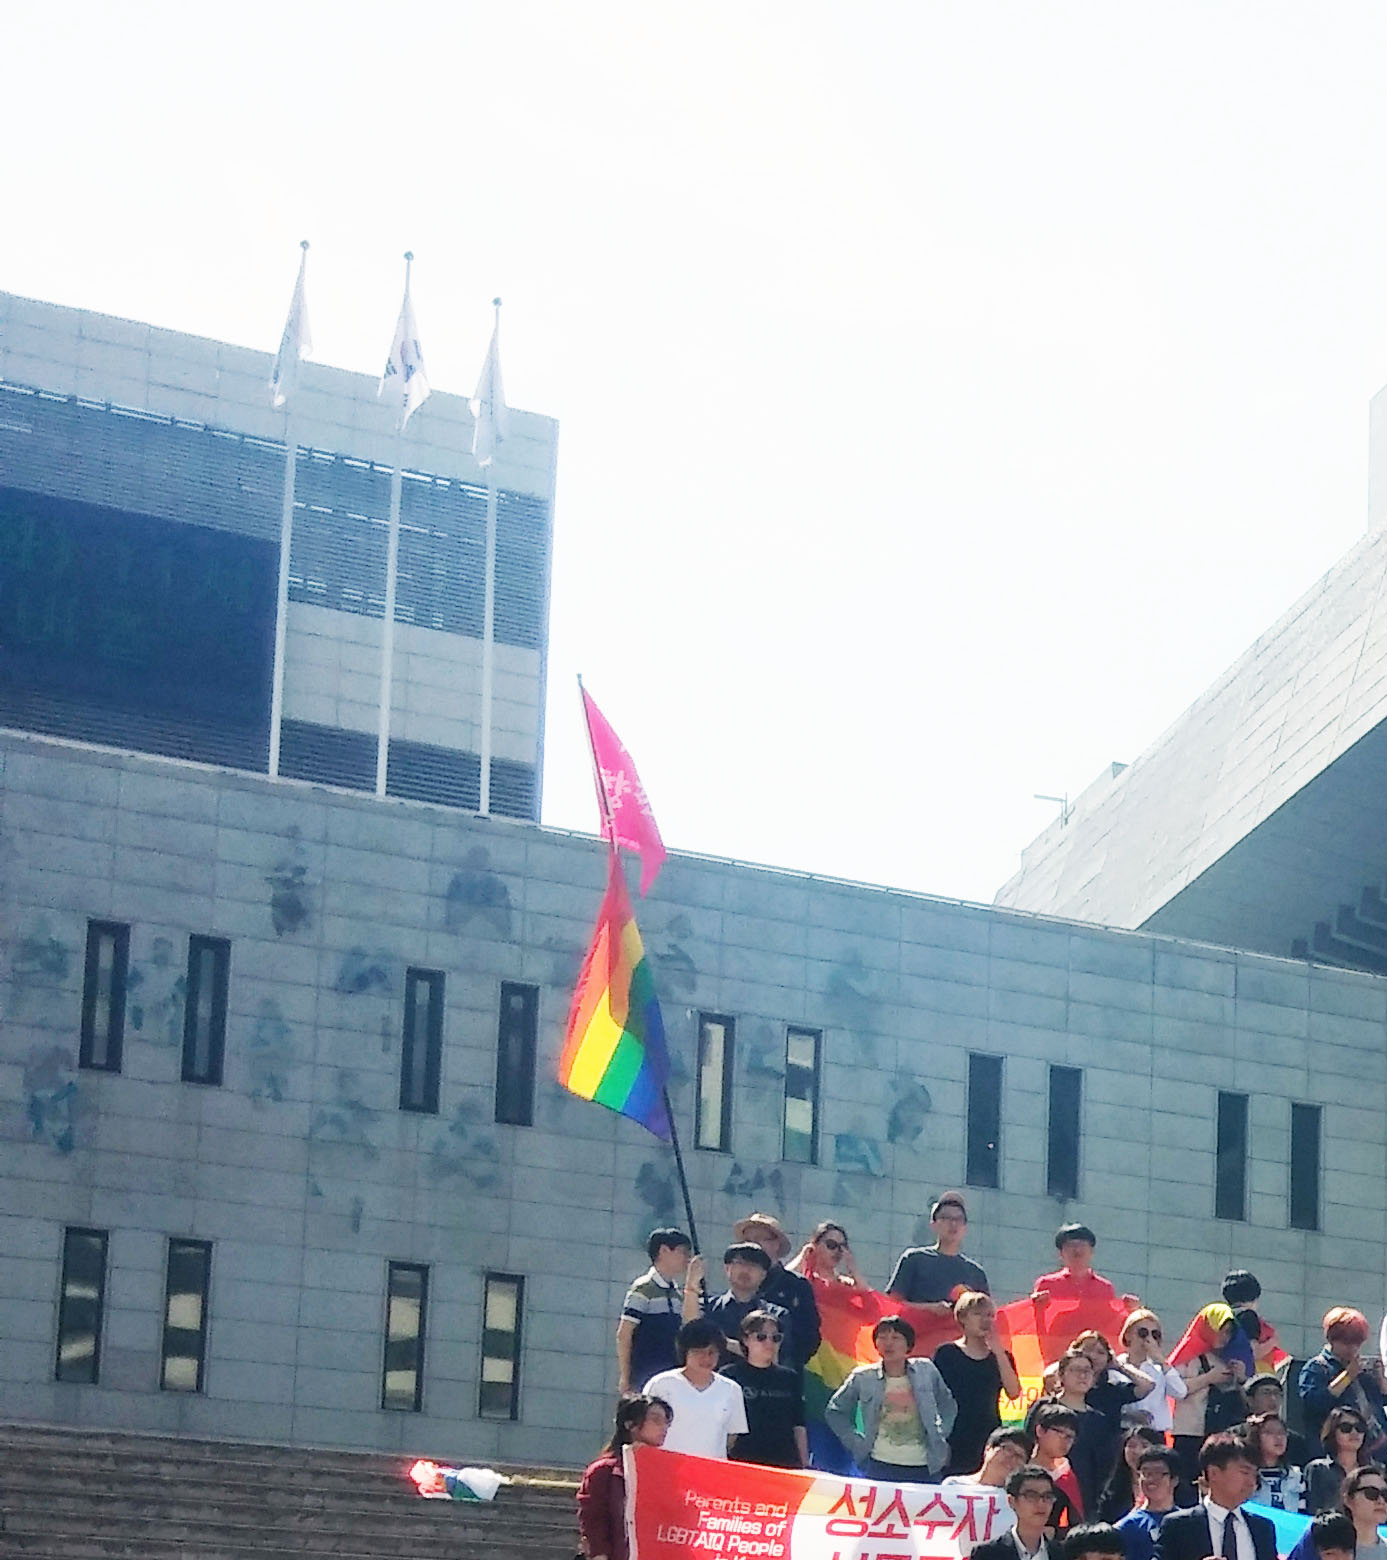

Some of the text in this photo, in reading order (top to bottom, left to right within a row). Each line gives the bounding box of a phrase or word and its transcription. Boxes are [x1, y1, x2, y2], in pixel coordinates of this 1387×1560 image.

[684, 1489, 788, 1519] Parents and
[825, 1482, 1001, 1542] 성소수자
[697, 1511, 787, 1537] Families of
[656, 1524, 785, 1557] LGBTAIQ People
